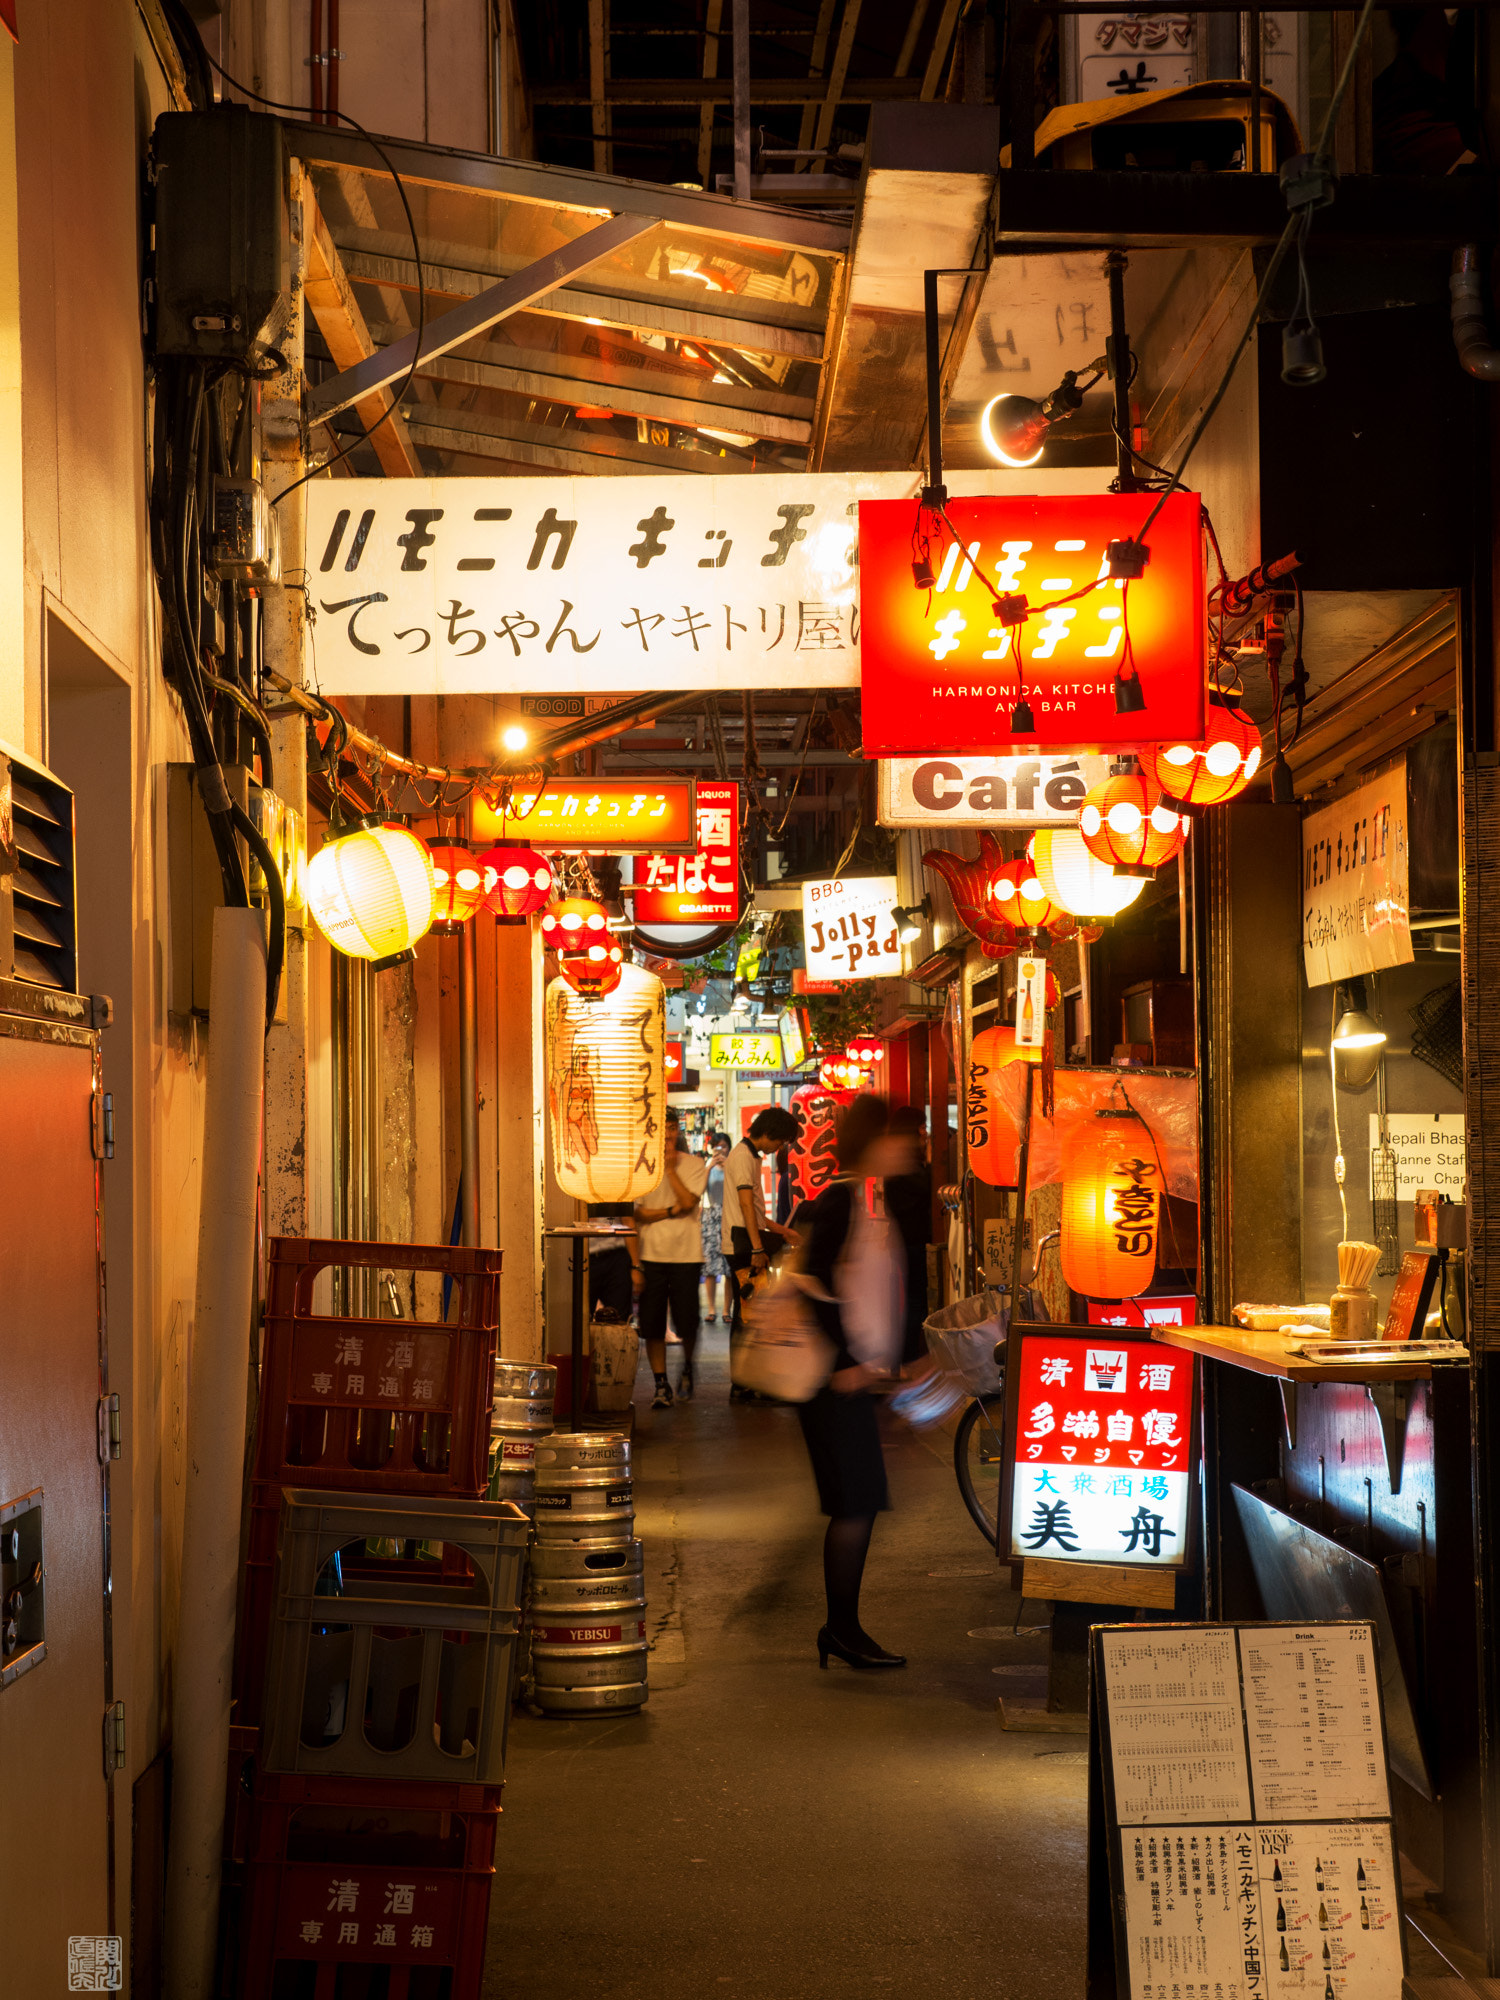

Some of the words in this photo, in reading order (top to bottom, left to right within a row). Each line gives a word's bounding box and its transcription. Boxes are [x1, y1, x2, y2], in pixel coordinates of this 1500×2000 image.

[319, 507, 579, 573] ハモニカ
[319, 591, 601, 657] てっちゃん
[928, 607, 1124, 661] キッチン
[932, 684, 1043, 697] HARMONICA
[1052, 683, 1117, 695] KITCHE
[522, 699, 583, 714] FOOD
[995, 702, 1031, 713] AN
[1041, 701, 1077, 712] BAR
[696, 790, 732, 800] LIQUOR
[911, 760, 1087, 811] Café
[645, 851, 735, 894] たばこ
[811, 881, 844, 902] BBQ
[678, 904, 732, 913] CIGARETTE
[810, 912, 877, 954] Jolly
[730, 1038, 763, 1050] 餃子
[716, 1050, 777, 1066] みんみん
[620, 1008, 658, 1176] てっちゃん
[1381, 1132, 1426, 1147] Nepali
[334, 1335, 416, 1369] 清酒
[310, 1371, 436, 1400] 専用通箱
[1039, 1356, 1074, 1388] 清
[1139, 1363, 1176, 1392] 酒
[1026, 1443, 1178, 1468] タマジマン
[1032, 1468, 1170, 1501] 大衆酒場
[1019, 1499, 1177, 1558] 美舟
[576, 1584, 629, 1596] サッポロビール
[569, 1628, 611, 1641] YEBISU
[1260, 1833, 1294, 1844] WINE
[1261, 1844, 1289, 1854] LIST
[326, 1878, 417, 1915] 清酒
[298, 1919, 436, 1948] 専用通箱
